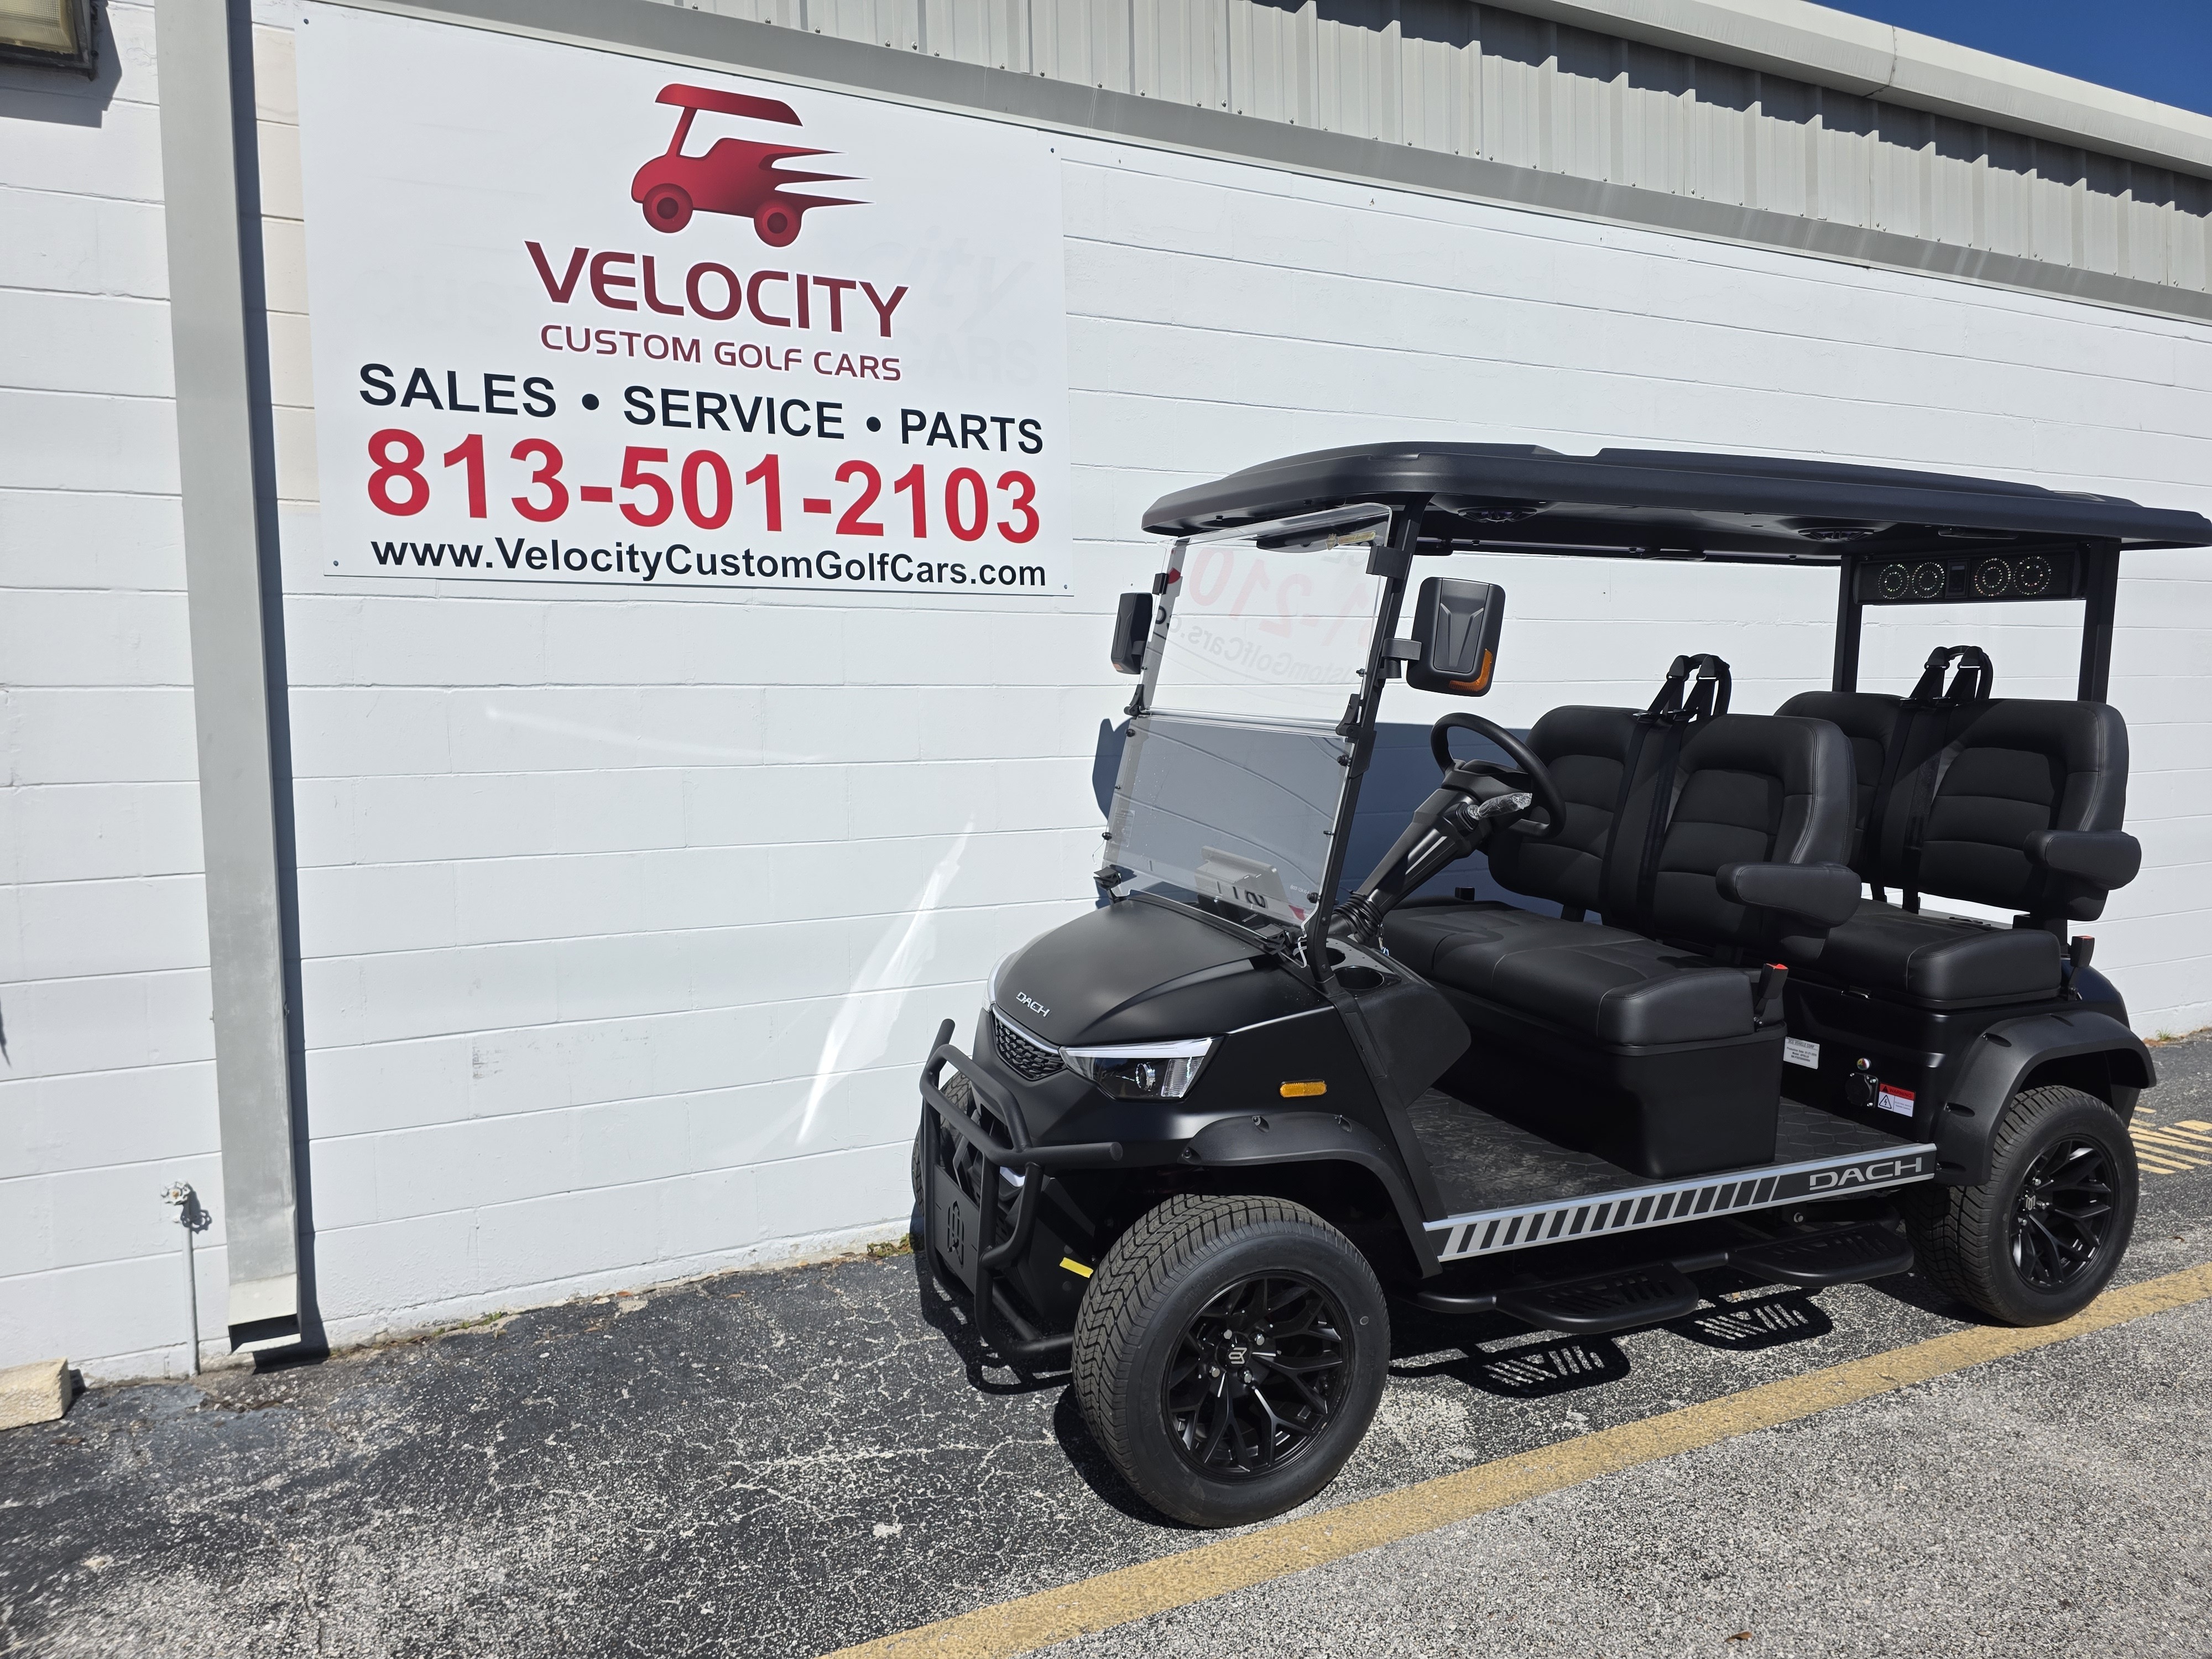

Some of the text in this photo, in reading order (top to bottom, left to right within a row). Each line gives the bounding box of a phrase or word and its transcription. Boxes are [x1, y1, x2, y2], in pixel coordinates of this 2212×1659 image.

[525, 241, 908, 338] VELOCITY
[540, 324, 902, 382] CUSTOM GOLF CARS
[359, 363, 1044, 455] SALES SERVICE PARTS
[367, 428, 1040, 544] 813-501-2103
[371, 537, 1046, 587] www.VelocityCustomGolfCars.com
[1016, 992, 1050, 1017] DACH
[1889, 1088, 1912, 1098] WARNING
[1809, 1157, 1922, 1191] DACH
